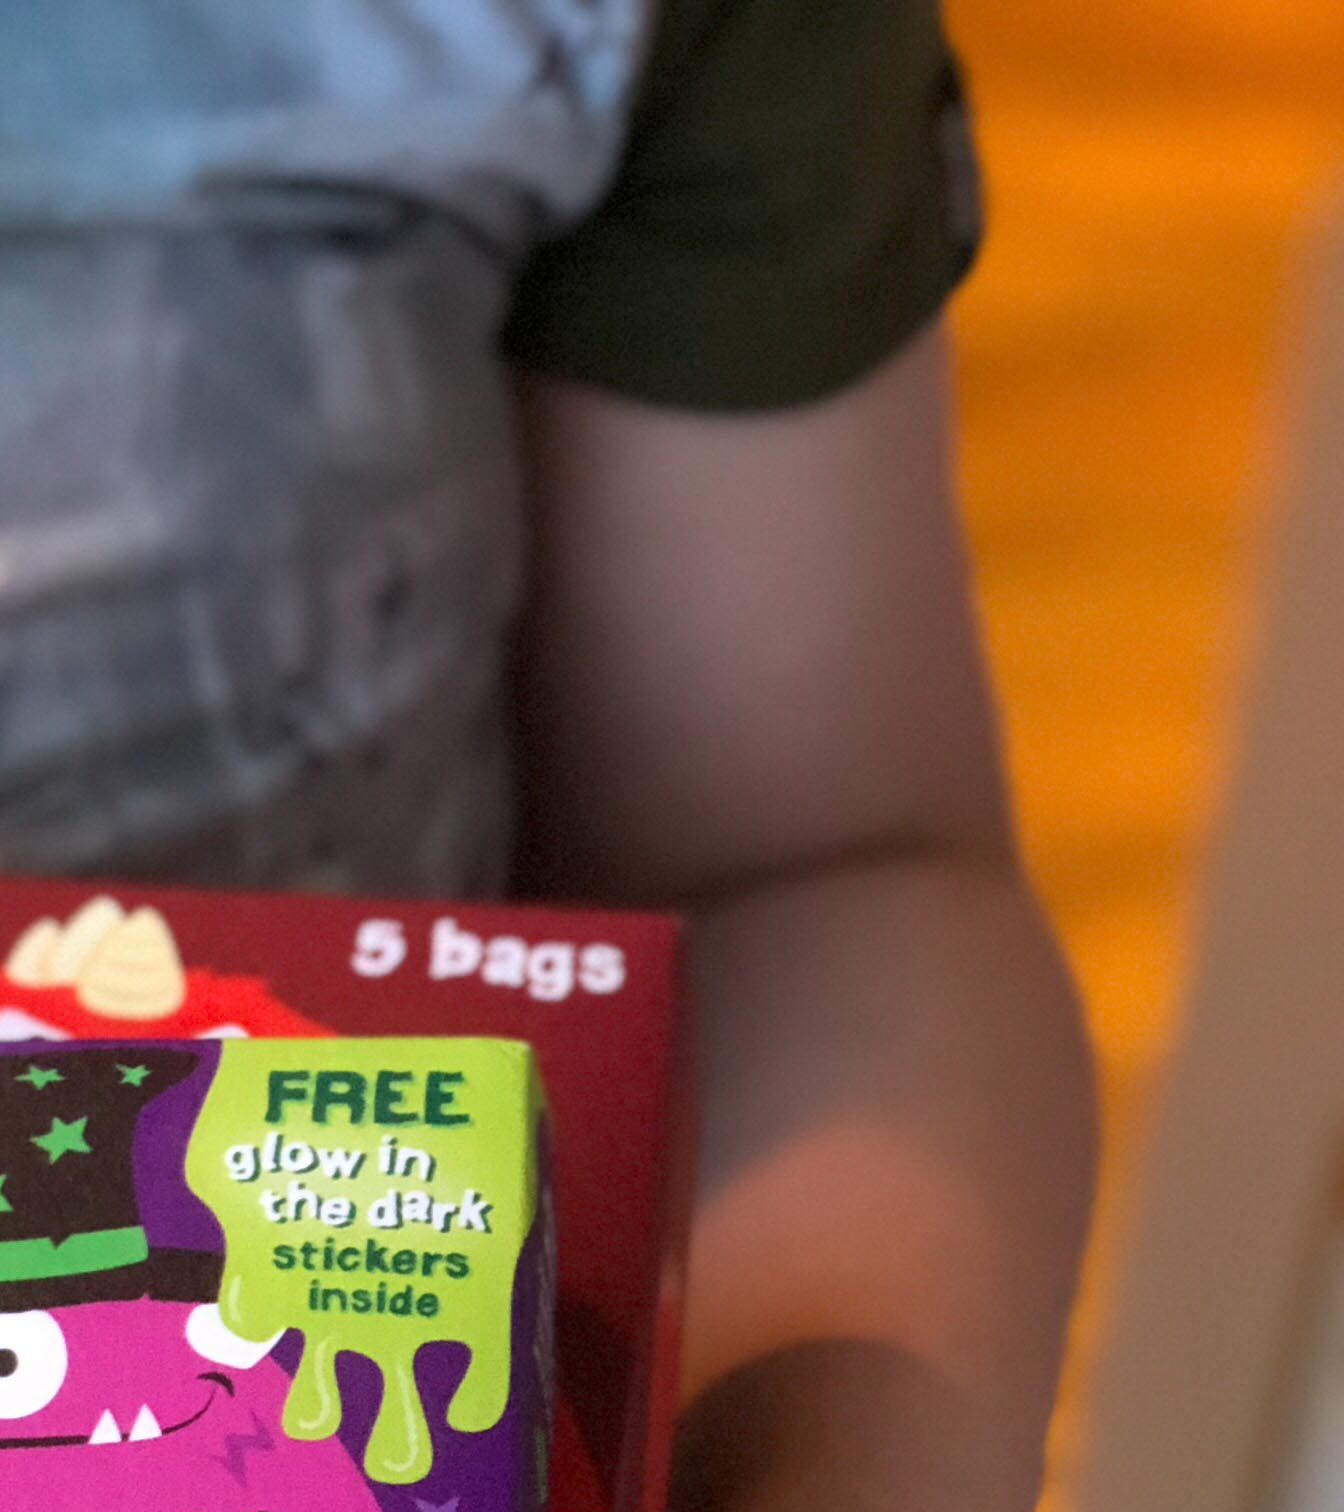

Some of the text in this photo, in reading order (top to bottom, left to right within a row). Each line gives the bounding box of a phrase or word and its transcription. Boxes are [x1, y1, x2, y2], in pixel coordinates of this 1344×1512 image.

[351, 916, 626, 1001] 5 bags
[265, 1069, 471, 1126] FREE
[224, 1131, 437, 1184] glow in
[259, 1180, 494, 1234] the dark
[272, 1236, 470, 1280] stickers
[308, 1279, 440, 1318] inside
